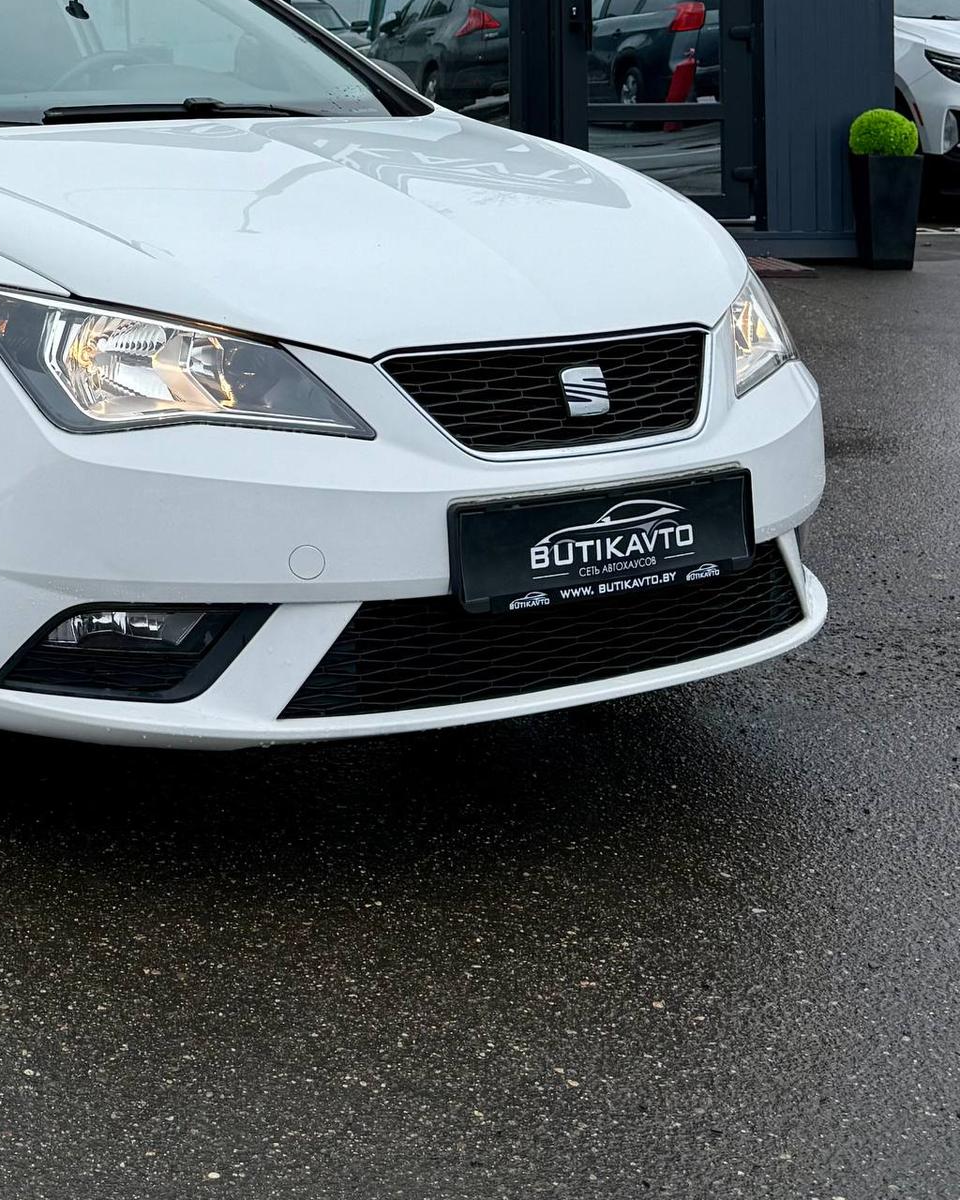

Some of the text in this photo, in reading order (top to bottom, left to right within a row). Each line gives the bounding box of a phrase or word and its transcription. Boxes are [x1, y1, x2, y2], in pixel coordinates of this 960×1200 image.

[530, 524, 694, 570] BUTIKAVTO
[578, 556, 657, 577] СЕТЬ АВТОХАУСОВ
[560, 571, 677, 599] WWW. BUTIKAVTO.BY
[509, 598, 550, 610] BUTIKAVTO
